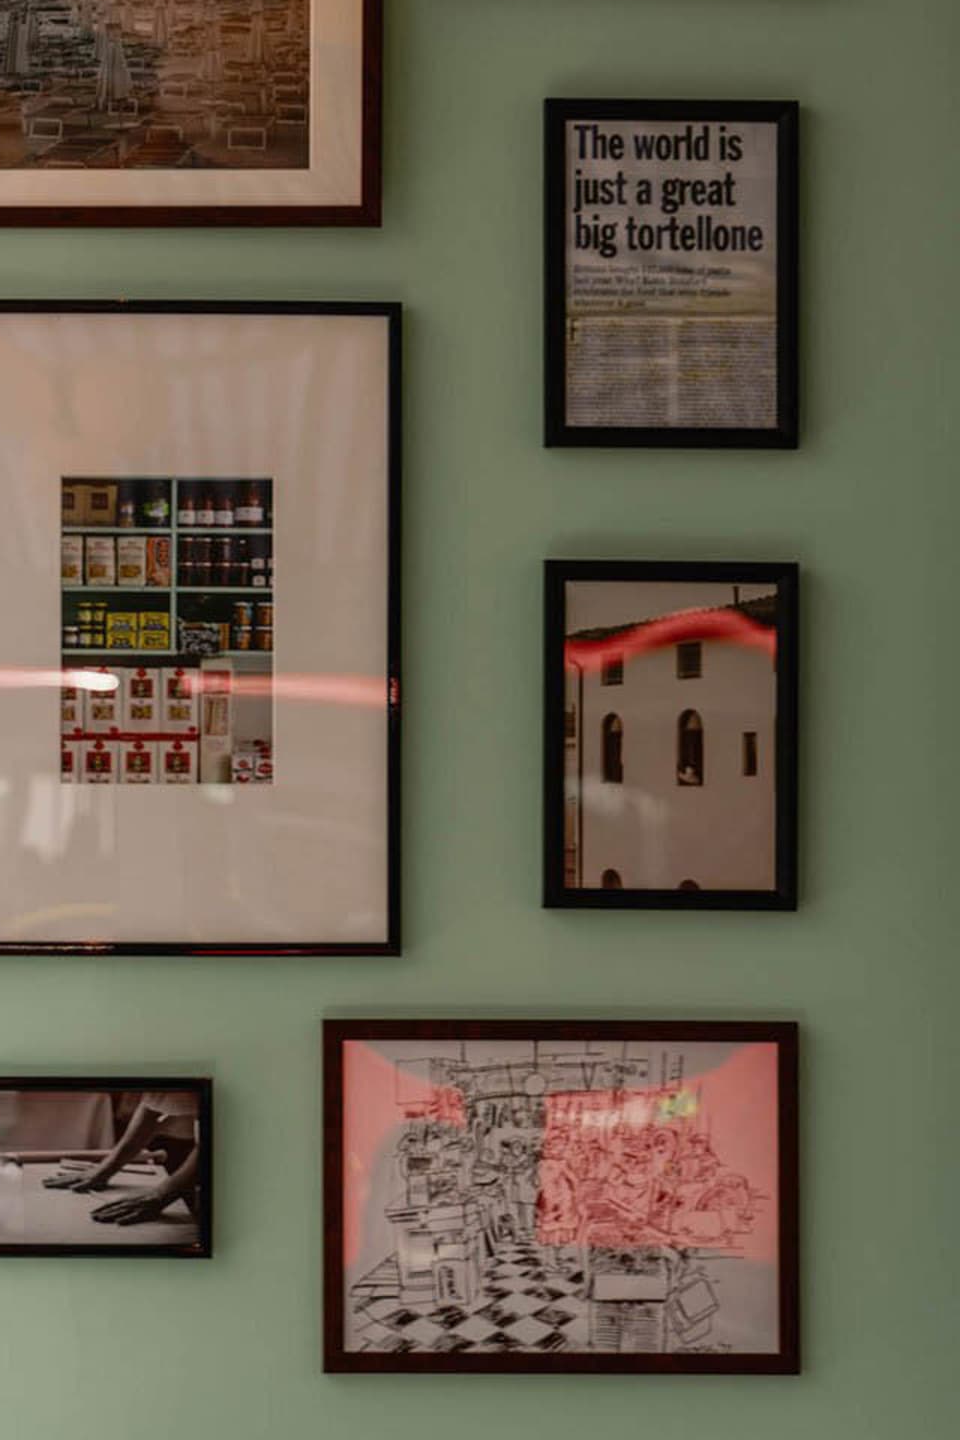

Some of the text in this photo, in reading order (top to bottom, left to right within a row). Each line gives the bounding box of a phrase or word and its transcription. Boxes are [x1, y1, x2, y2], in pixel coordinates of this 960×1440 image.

[574, 124, 743, 161] The world is
[573, 169, 736, 214] just a great
[574, 214, 764, 258] big tortellone
